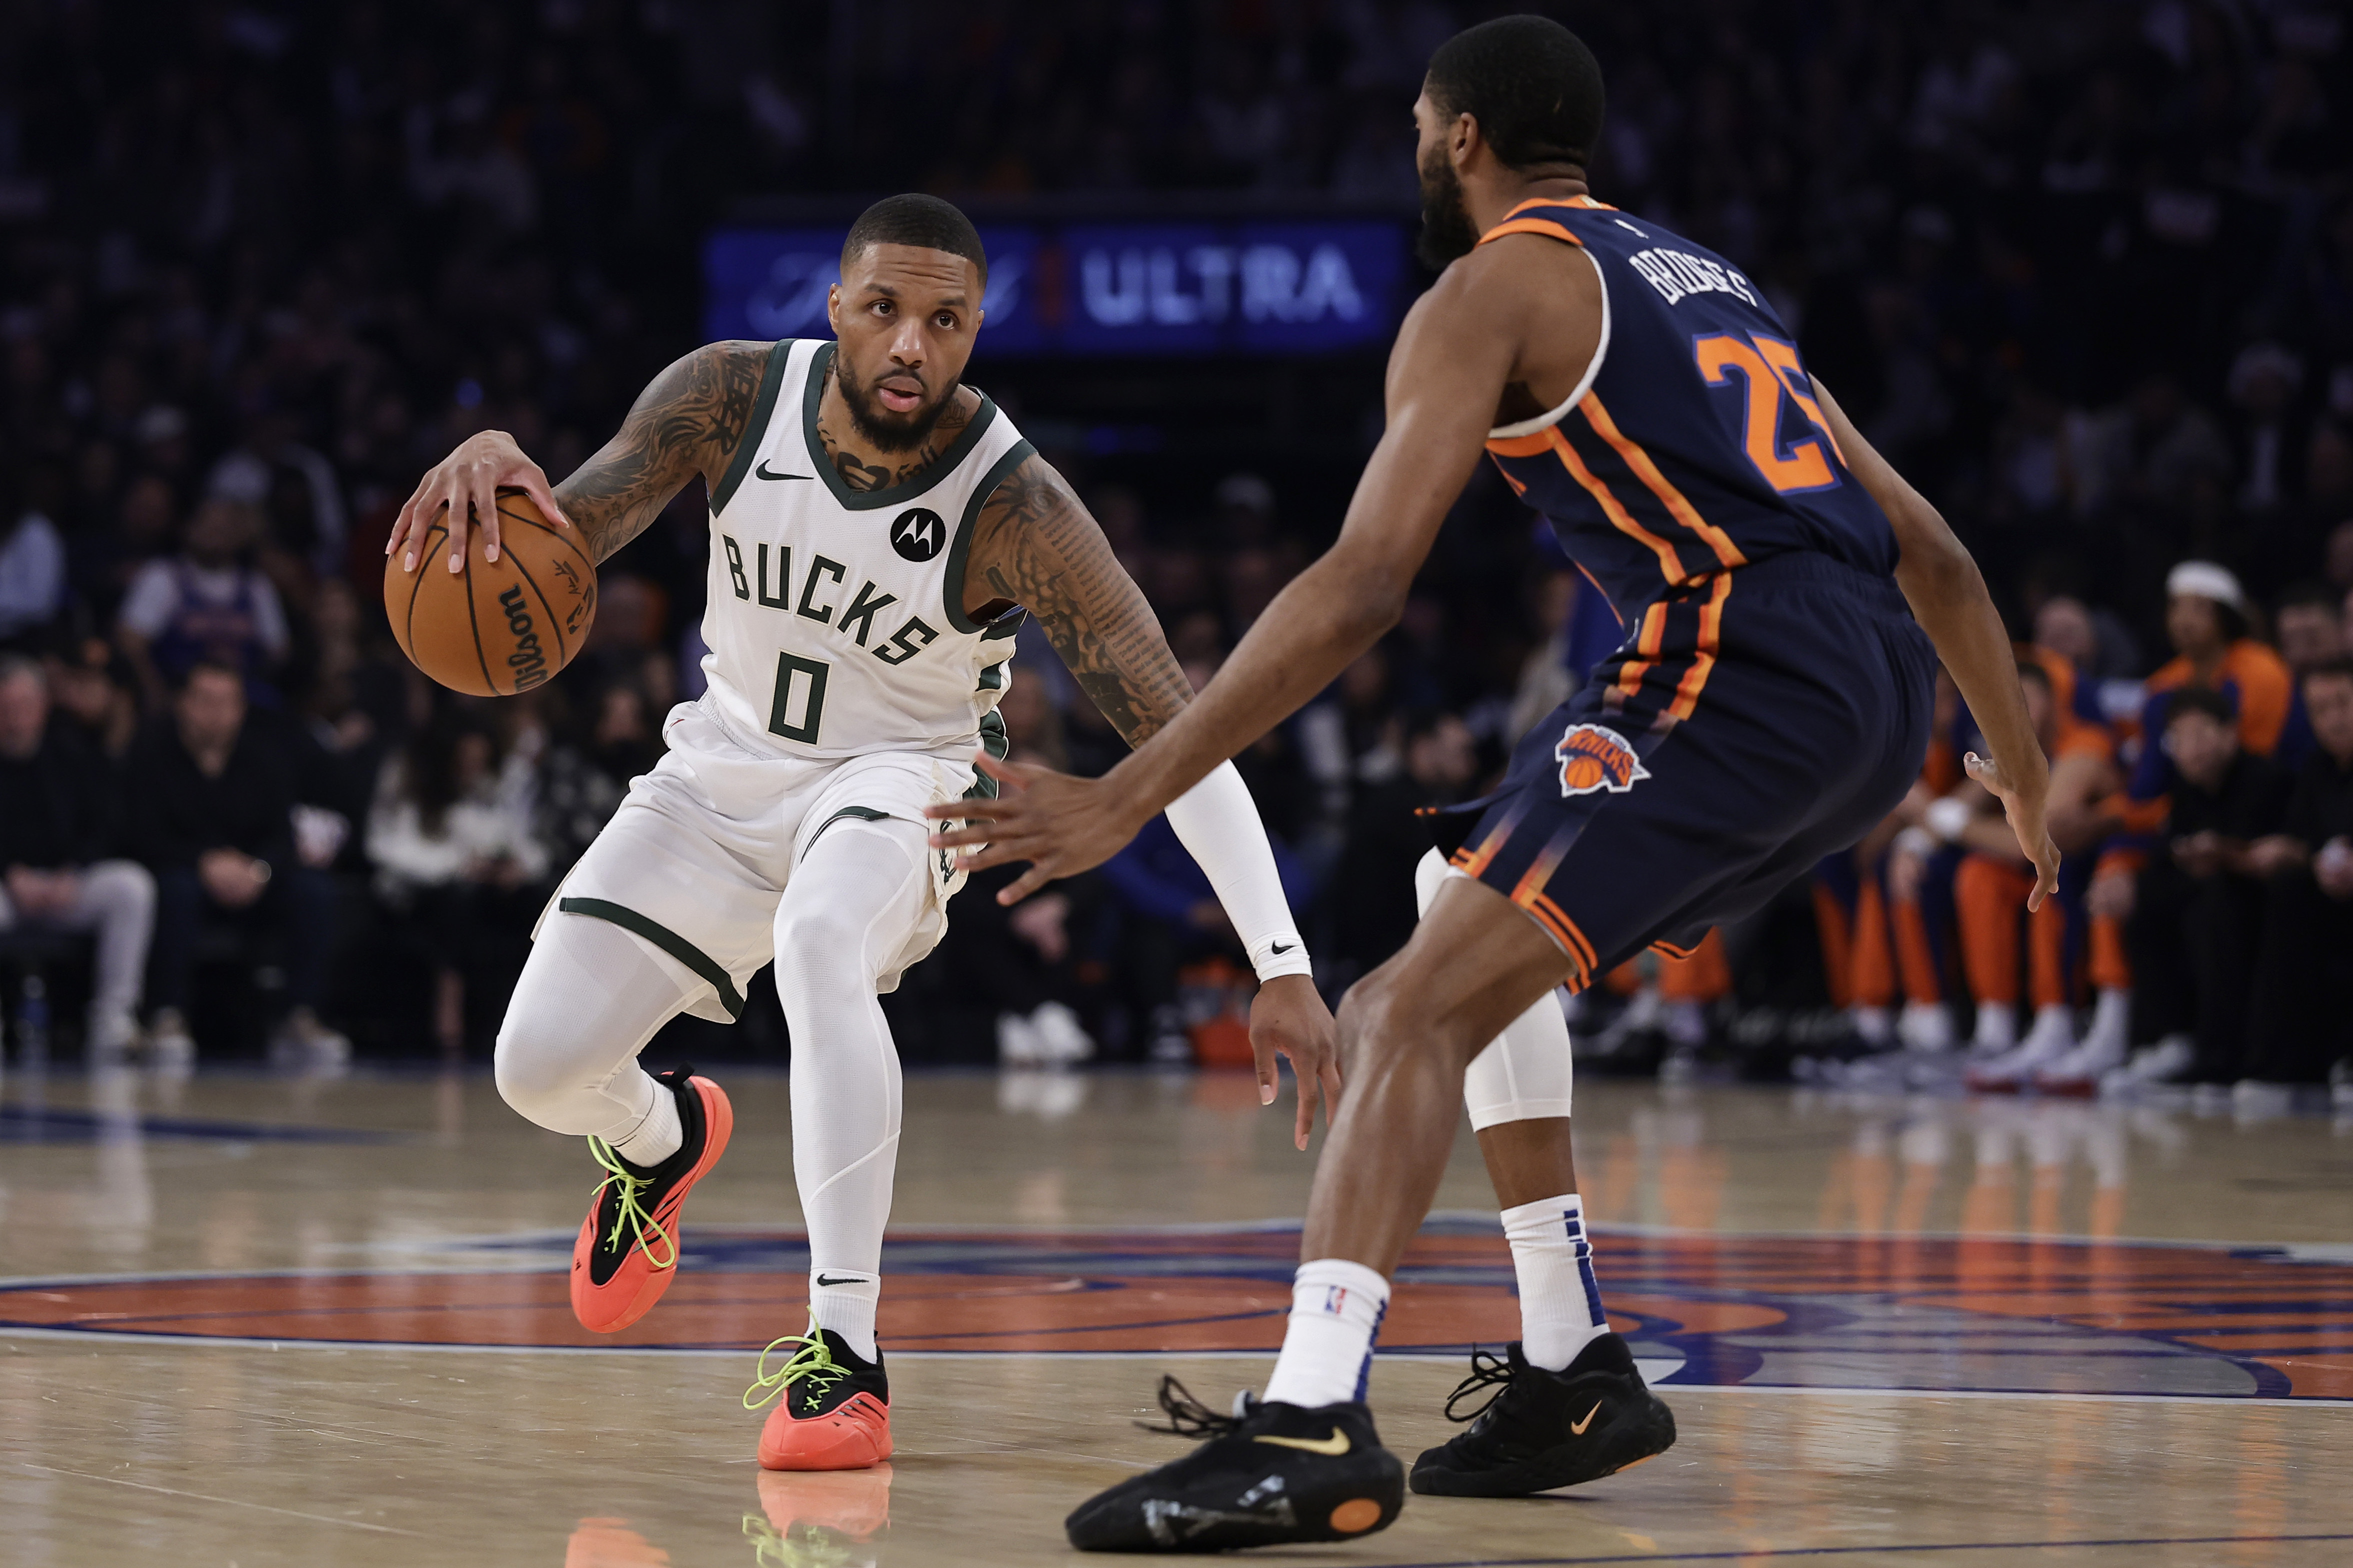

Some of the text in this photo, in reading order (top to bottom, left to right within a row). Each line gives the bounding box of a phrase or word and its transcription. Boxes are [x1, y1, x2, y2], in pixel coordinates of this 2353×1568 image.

[1081, 246, 1363, 326] ULTRA
[1628, 247, 1758, 306] BRIDGES
[1692, 329, 1848, 496] 25
[721, 533, 943, 666] BUCKS
[767, 649, 832, 747] 0
